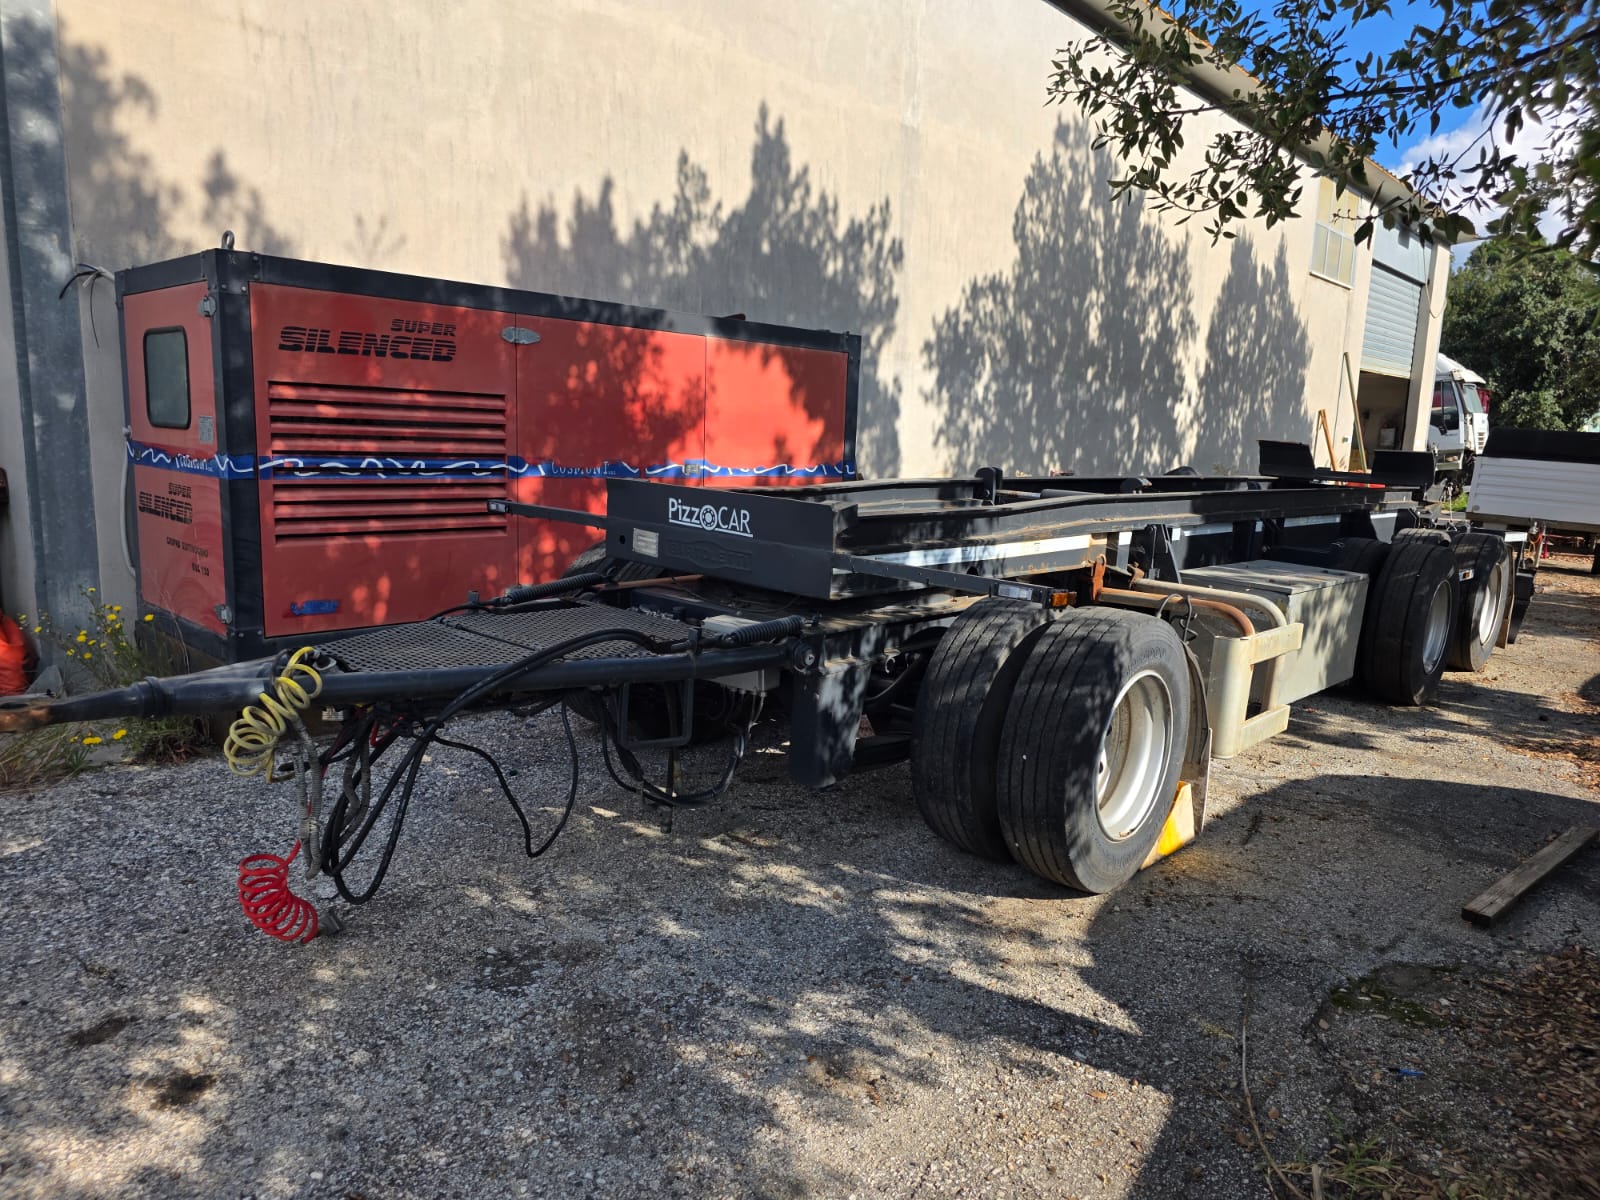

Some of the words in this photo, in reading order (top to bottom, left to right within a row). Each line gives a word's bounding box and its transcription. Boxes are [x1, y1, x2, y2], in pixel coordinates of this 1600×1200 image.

[391, 319, 456, 336] SUPER
[279, 326, 456, 362] SILENCED
[168, 482, 192, 499] SUPER
